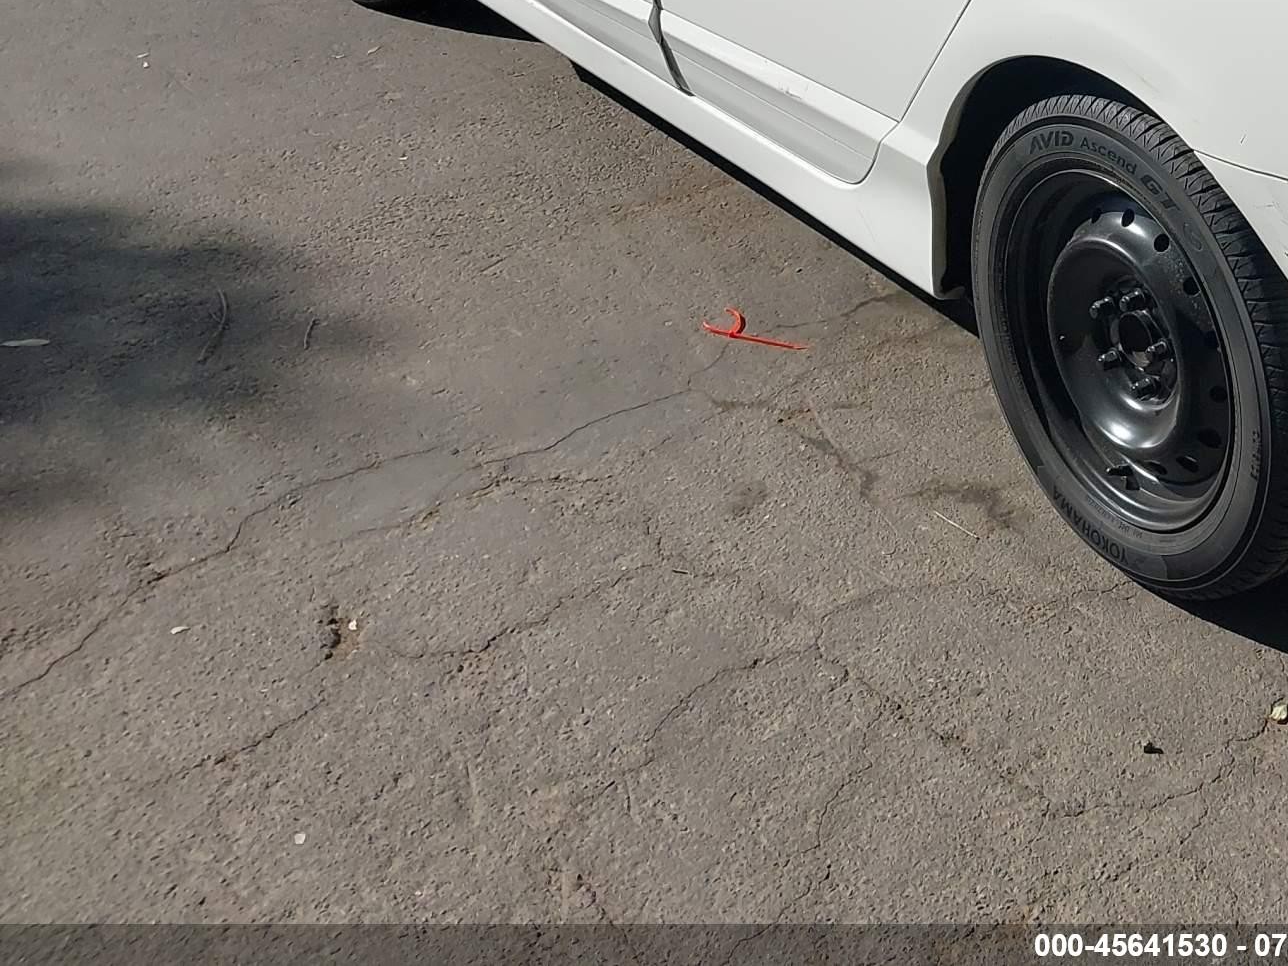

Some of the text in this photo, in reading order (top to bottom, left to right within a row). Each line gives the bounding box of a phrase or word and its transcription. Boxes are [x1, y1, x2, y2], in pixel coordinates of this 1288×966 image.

[1029, 130, 1181, 212] AVID Ascend GT
[1053, 484, 1129, 566] YOKOHAMA
